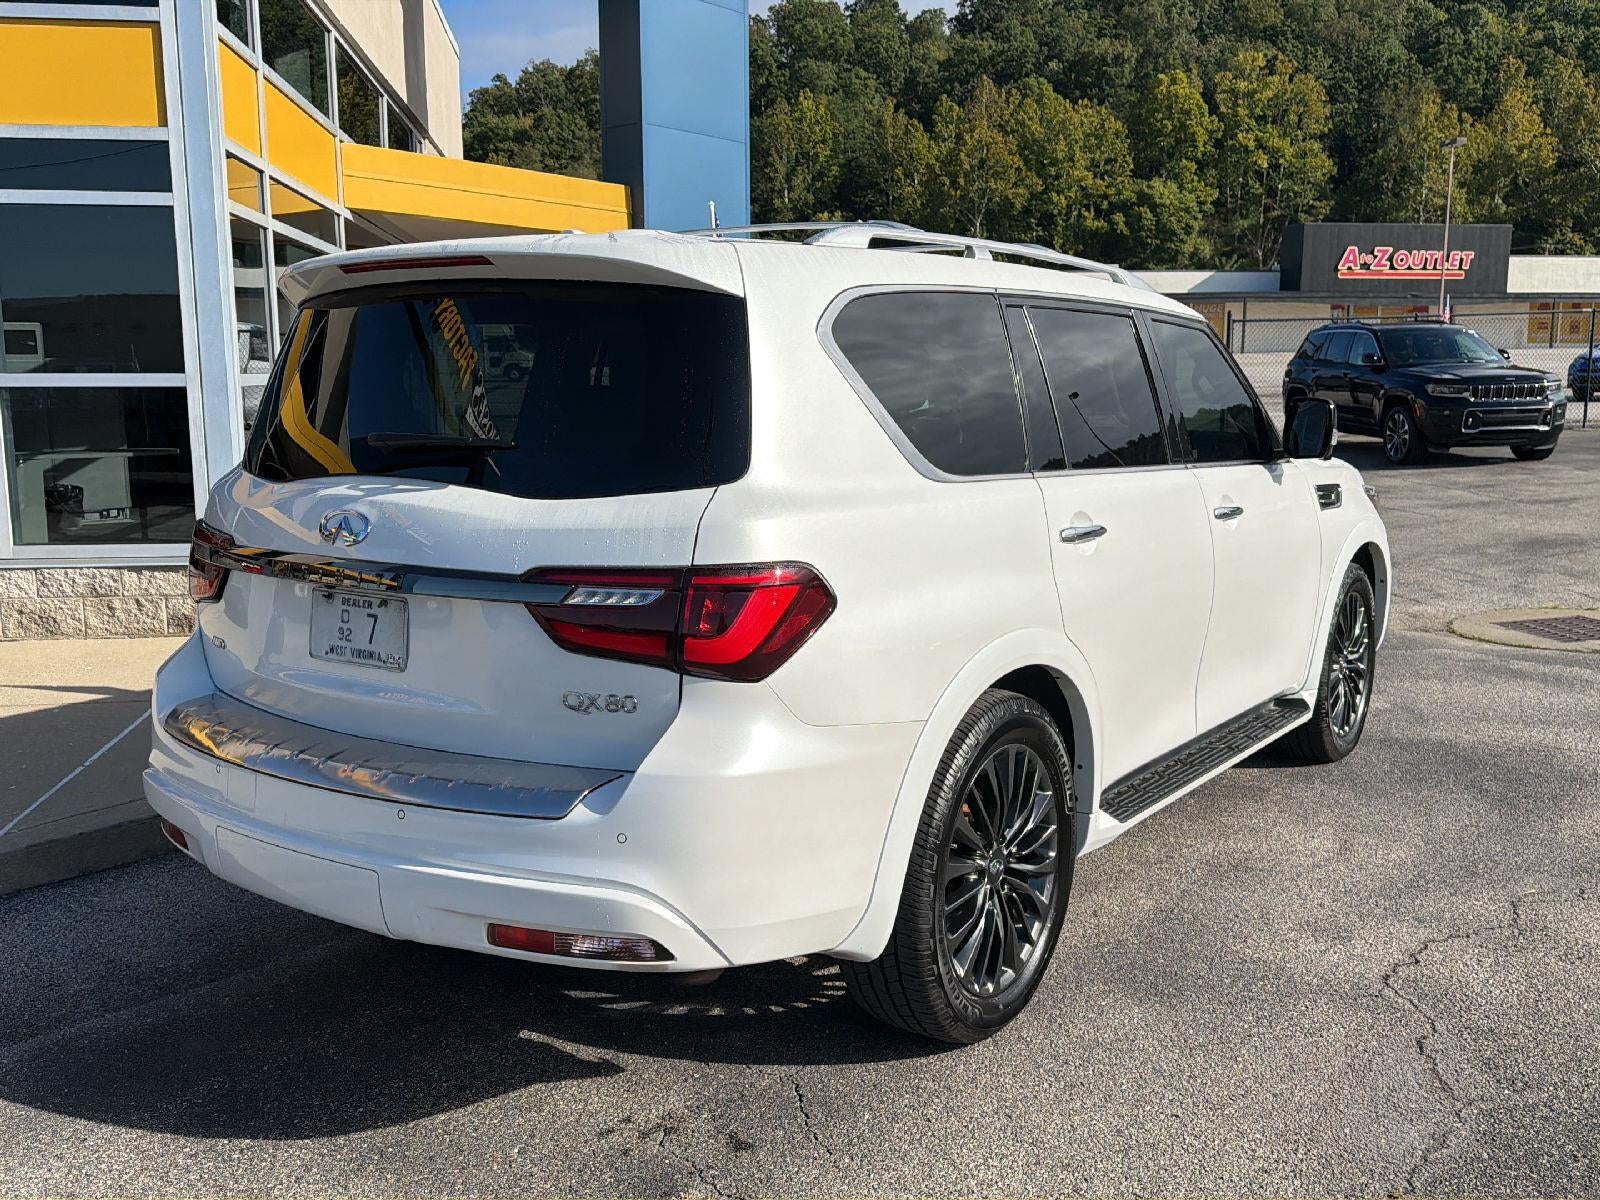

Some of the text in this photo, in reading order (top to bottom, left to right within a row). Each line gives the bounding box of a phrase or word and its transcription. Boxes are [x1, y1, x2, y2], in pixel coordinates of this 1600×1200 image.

[1393, 250, 1475, 269] OUTLET
[341, 597, 373, 609] DEALER
[337, 627, 352, 642] 92
[366, 613, 378, 645] 7
[328, 643, 347, 656] WEST
[350, 647, 382, 662] VIRGINIA
[562, 691, 637, 715] QX80
